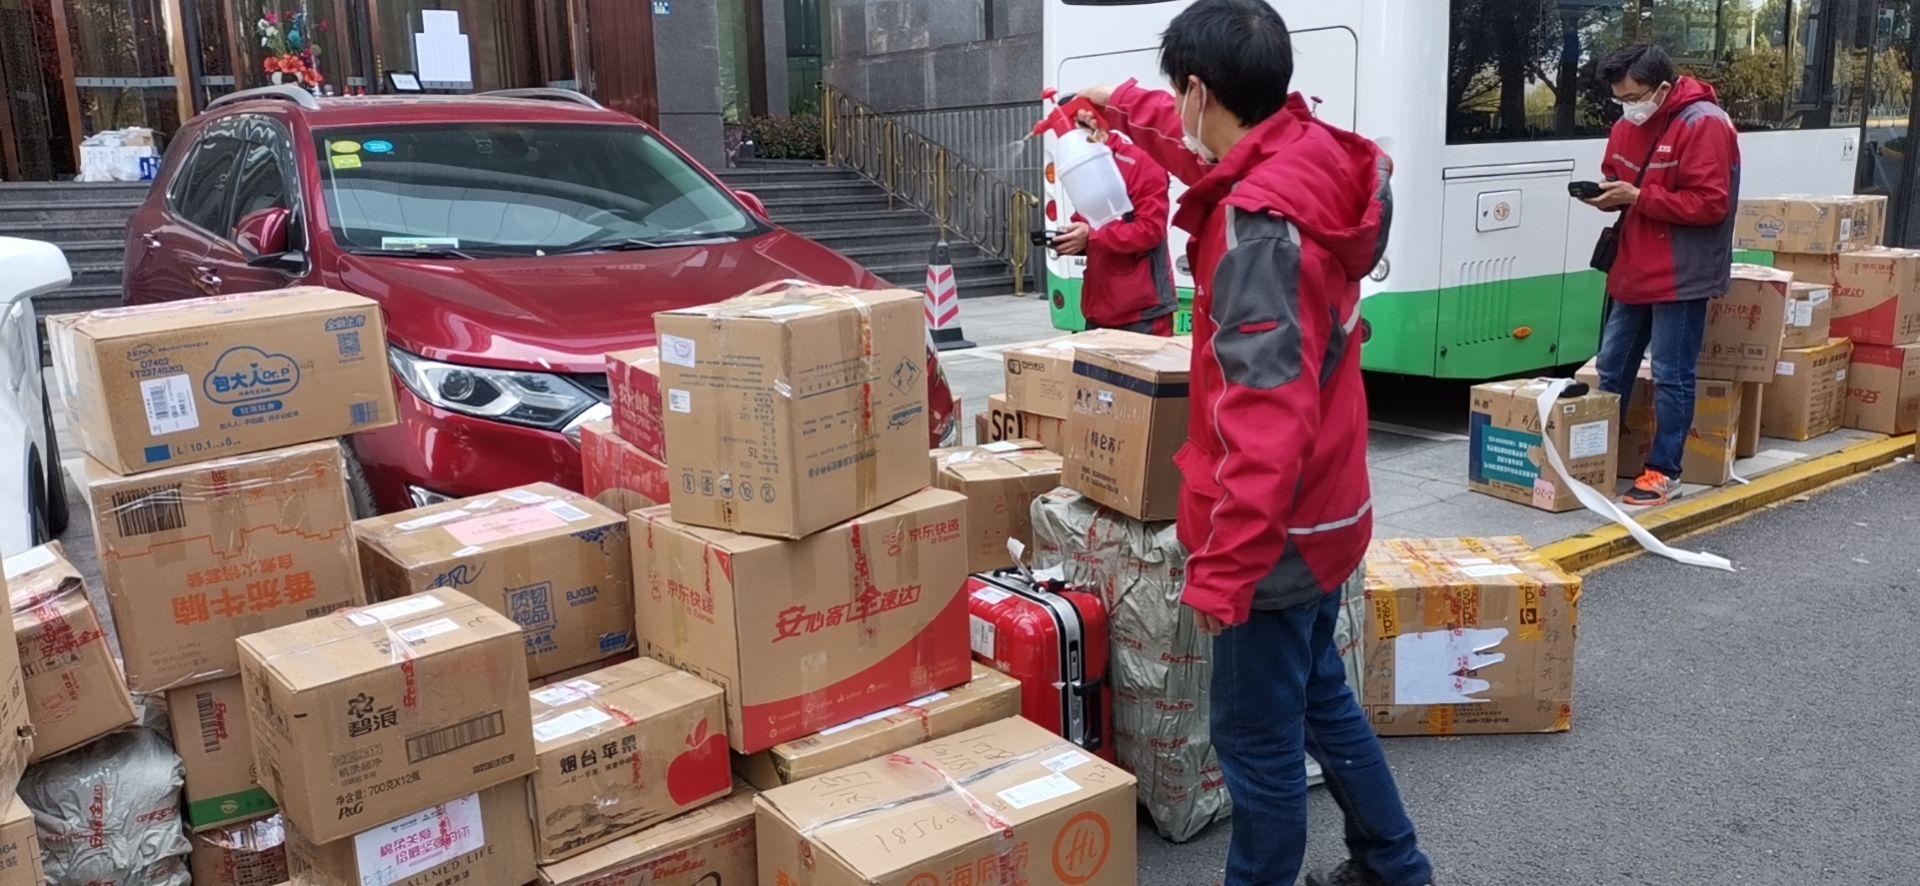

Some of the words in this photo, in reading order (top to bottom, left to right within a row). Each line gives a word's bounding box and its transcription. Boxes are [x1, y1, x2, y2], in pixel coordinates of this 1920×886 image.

[908, 518, 960, 542] 京东快递
[171, 570, 317, 626] 番茄牛腩
[566, 586, 599, 601] BJ03A
[666, 579, 714, 615] 京东快递
[348, 705, 399, 738] 碧浪
[560, 734, 637, 775] 烟台苹果
[338, 801, 364, 820] P&G
[467, 845, 496, 864] LIFE
[1066, 828, 1097, 871] Hi
